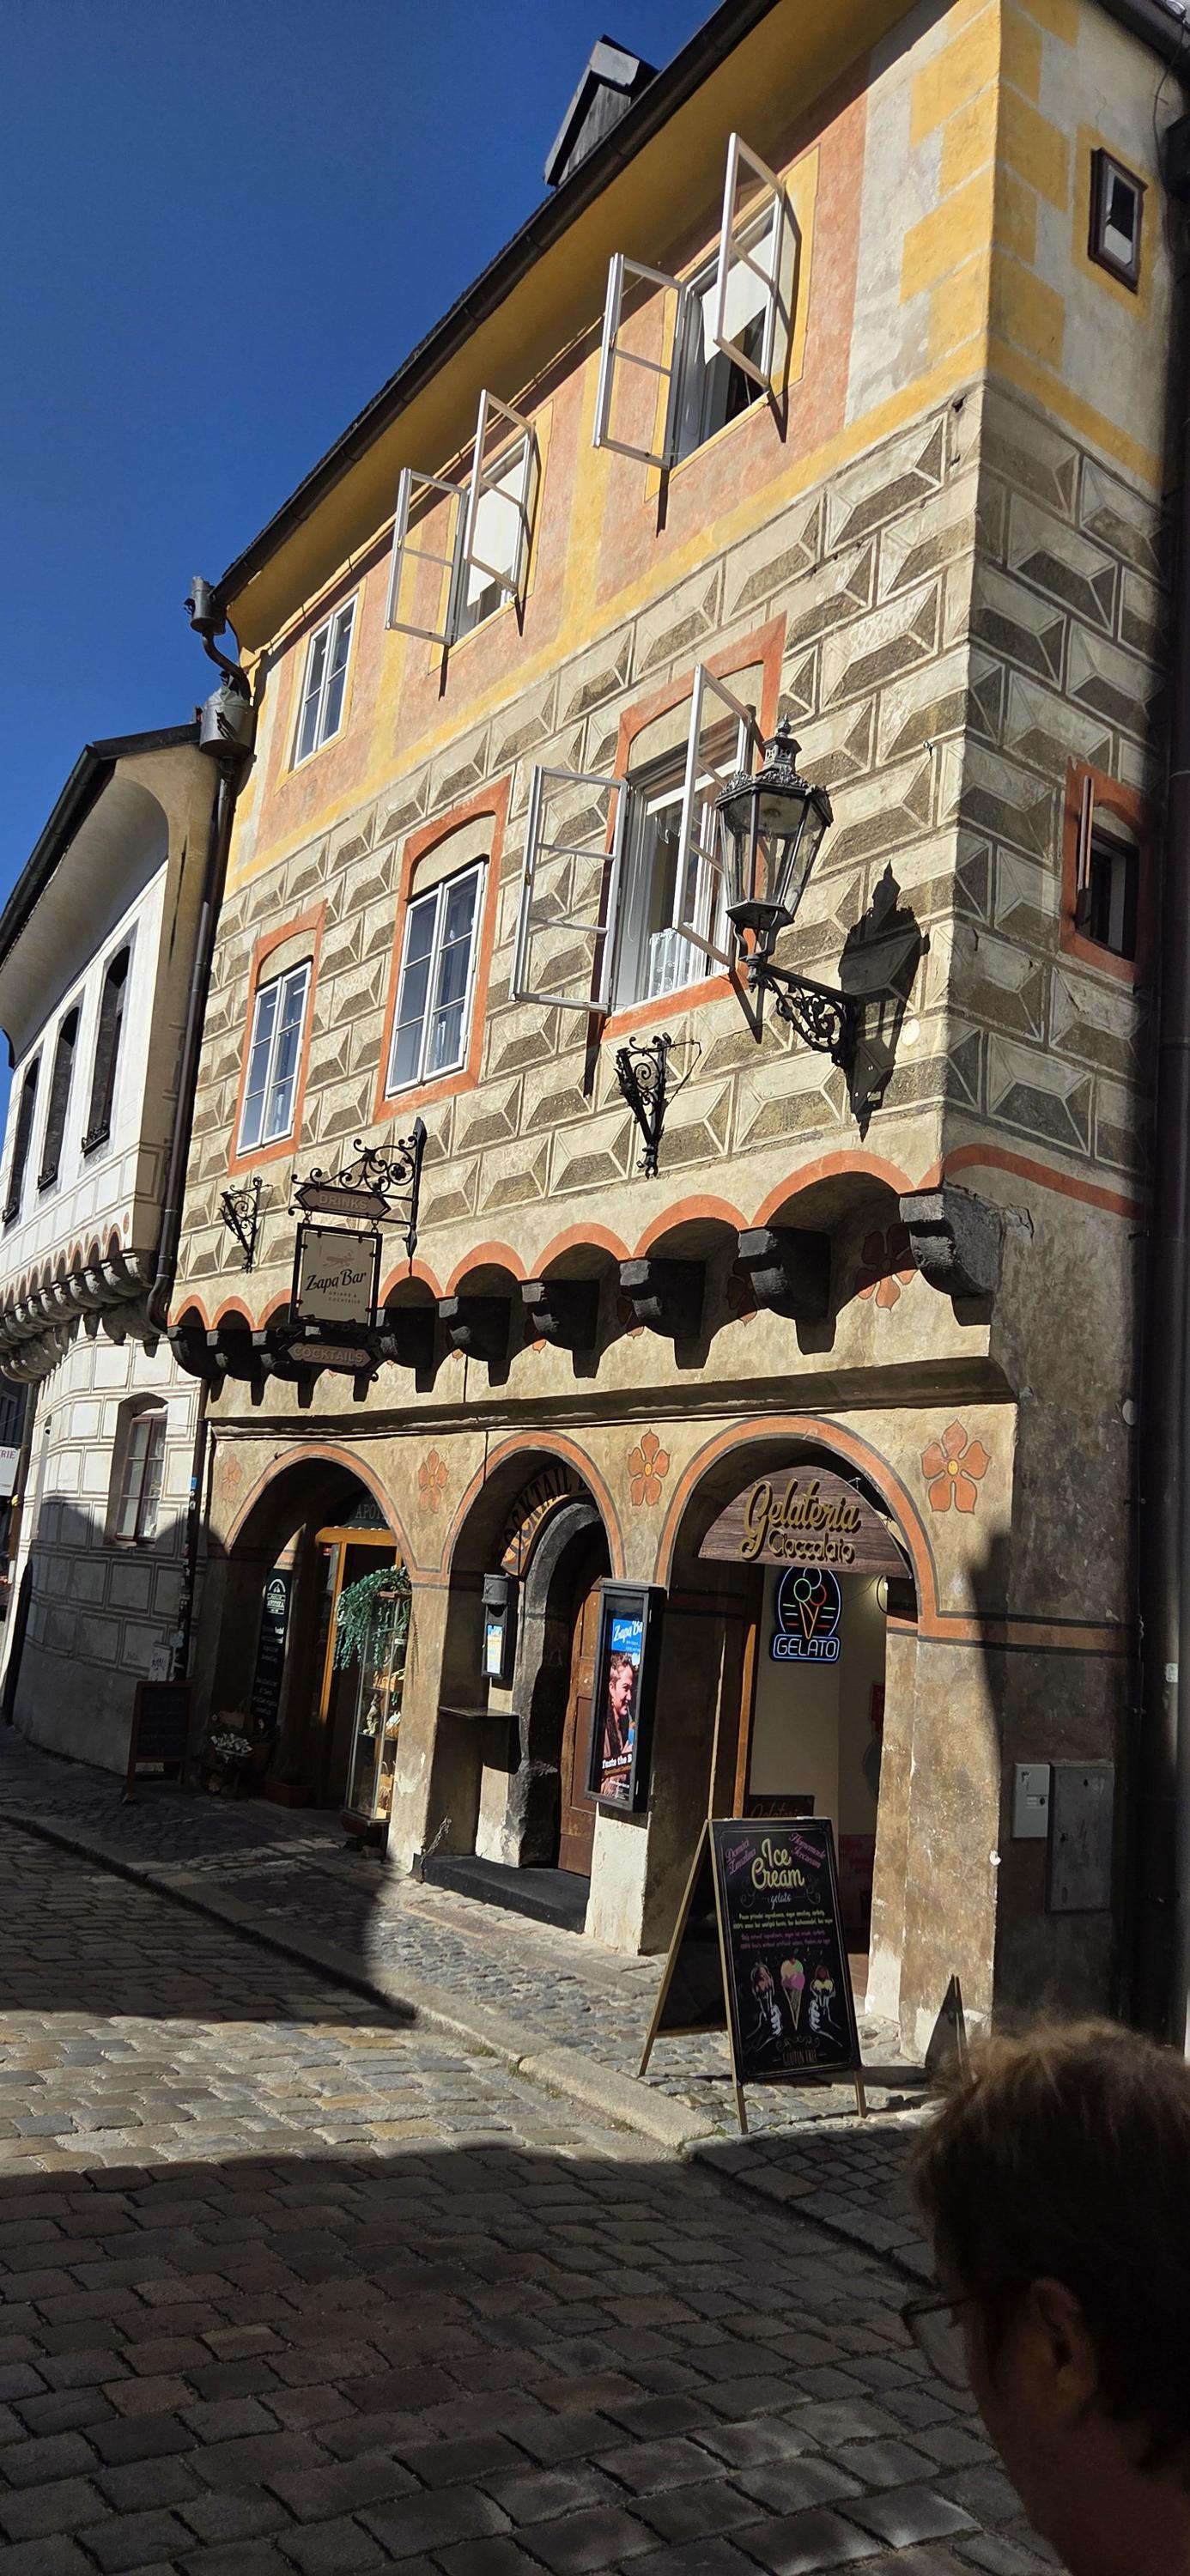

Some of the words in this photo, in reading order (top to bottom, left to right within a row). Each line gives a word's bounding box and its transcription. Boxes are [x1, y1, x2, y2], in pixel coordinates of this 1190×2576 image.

[319, 1193, 367, 1211] DRINKS
[305, 1274, 340, 1294] Zapa
[340, 1268, 367, 1286] Bar
[293, 1346, 364, 1364] COCKTAILS
[0, 1449, 16, 1460] RIE
[739, 1478, 861, 1561] Gelateria
[768, 1528, 855, 1564] Cioccolato
[776, 1637, 838, 1657] GELATO
[761, 1838, 792, 1868] Ice
[750, 1857, 805, 1890] Cream
